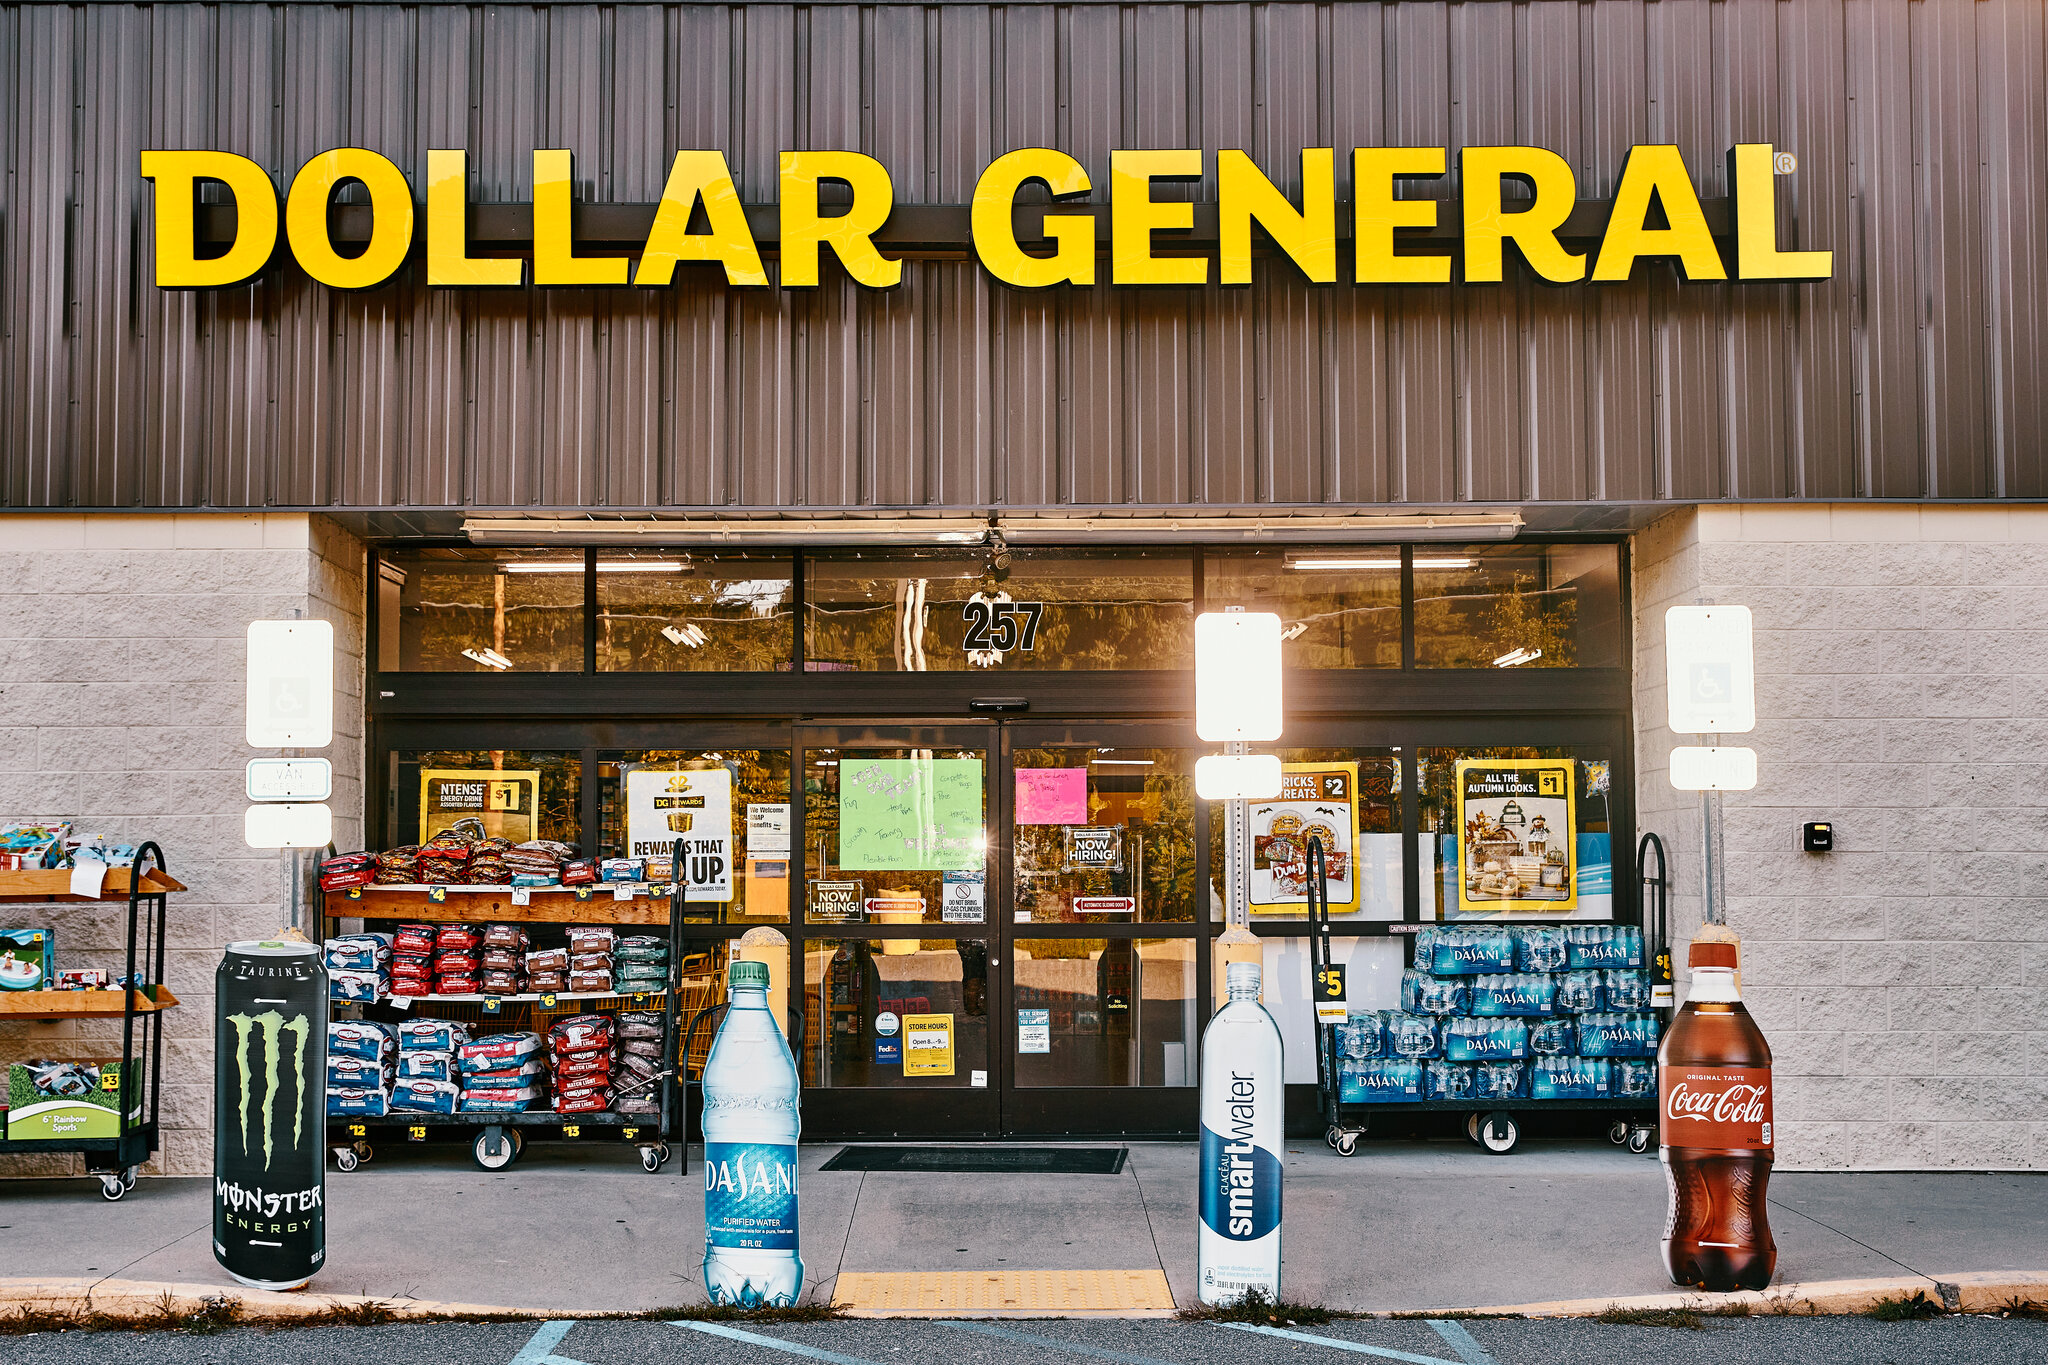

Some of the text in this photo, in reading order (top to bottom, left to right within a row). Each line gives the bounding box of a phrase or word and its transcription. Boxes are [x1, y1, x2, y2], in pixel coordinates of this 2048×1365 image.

[141, 143, 1833, 290] DOLLAR GENERAL
[963, 602, 1043, 652] 257
[275, 768, 303, 780] VAN
[850, 763, 882, 787] JOIN
[1485, 773, 1519, 782] ALL THE
[866, 773, 896, 795] OUR
[1282, 776, 1317, 788] RICKS,
[1325, 778, 1343, 795] $2
[1468, 783, 1537, 793] AUTUMN LOOKS.
[1543, 777, 1557, 793] $1
[440, 783, 483, 795] NTENSE
[495, 789, 511, 807] $1
[656, 799, 669, 807] DG
[634, 839, 723, 856] REWARS THAT
[1075, 839, 1109, 850] NOW
[1069, 849, 1116, 861] HIRING!
[692, 856, 726, 884] UP.
[819, 891, 852, 902] NOW
[812, 901, 860, 913] HIRING!
[1454, 946, 1500, 963] DASANI
[1581, 945, 1627, 962] DASANI
[240, 965, 302, 977] TAURINE
[1317, 970, 1342, 996] $5
[540, 995, 556, 1007] $6
[1494, 990, 1539, 1005] DASANI
[1601, 1027, 1645, 1043] DASANI
[582, 1039, 597, 1047] LIGHT
[878, 1045, 897, 1053] FedEx
[1466, 1037, 1511, 1053] DASANI
[103, 1075, 118, 1086] $3
[582, 1078, 596, 1086] LIGHT
[1358, 1073, 1404, 1089] DASANI
[1550, 1070, 1595, 1087] DASANI
[1723, 1074, 1745, 1082] TASTE
[1667, 1082, 1767, 1123] Coca-Cola
[53, 1115, 88, 1123] Rainbow
[52, 1123, 77, 1134] Sports
[348, 1124, 366, 1136] $12
[409, 1126, 427, 1138] $13
[562, 1125, 580, 1137] $13
[1223, 1070, 1255, 1236] smartwater
[706, 1151, 797, 1203] DASANI
[1217, 1153, 1231, 1196] GLACÉAU
[216, 1176, 323, 1218] MONSTER
[1731, 1165, 1754, 1241] Coca-Cola
[226, 1212, 311, 1234] ENERGY
[723, 1217, 781, 1227] PURIFIED WATER
[740, 1239, 747, 1247] 20
